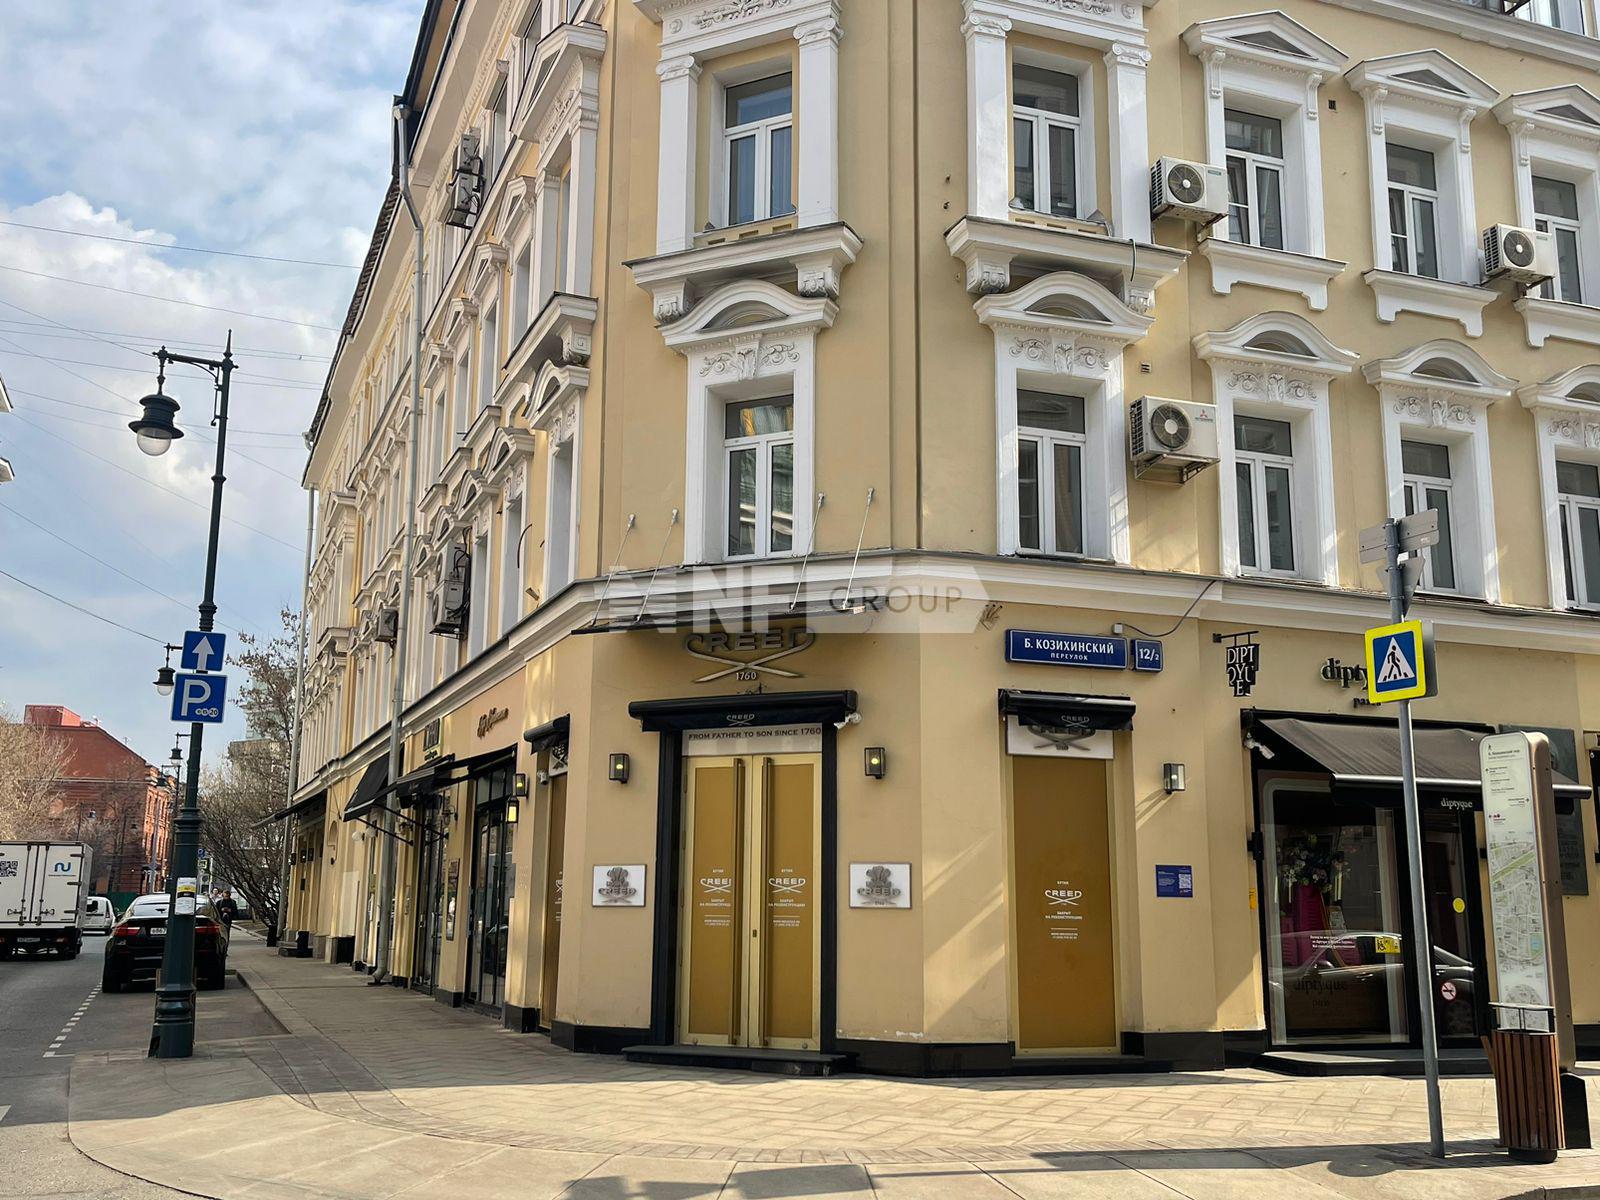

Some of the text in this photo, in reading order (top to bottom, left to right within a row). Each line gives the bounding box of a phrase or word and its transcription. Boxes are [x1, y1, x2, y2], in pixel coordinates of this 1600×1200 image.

[685, 626, 816, 653] CREED
[1024, 638, 1114, 655] Б. КОЗИХИНСКИЙ
[1050, 652, 1089, 661] ПЕРЕУЛОК
[1138, 648, 1160, 662] 12/2
[735, 671, 757, 681] 1760
[1320, 657, 1369, 691] dipty
[712, 731, 742, 739] FATHER
[775, 728, 799, 736] SINCE
[800, 727, 822, 735] 1760
[1440, 797, 1473, 810] diptyque
[769, 877, 806, 886] CREED
[1045, 889, 1082, 897] CREED
